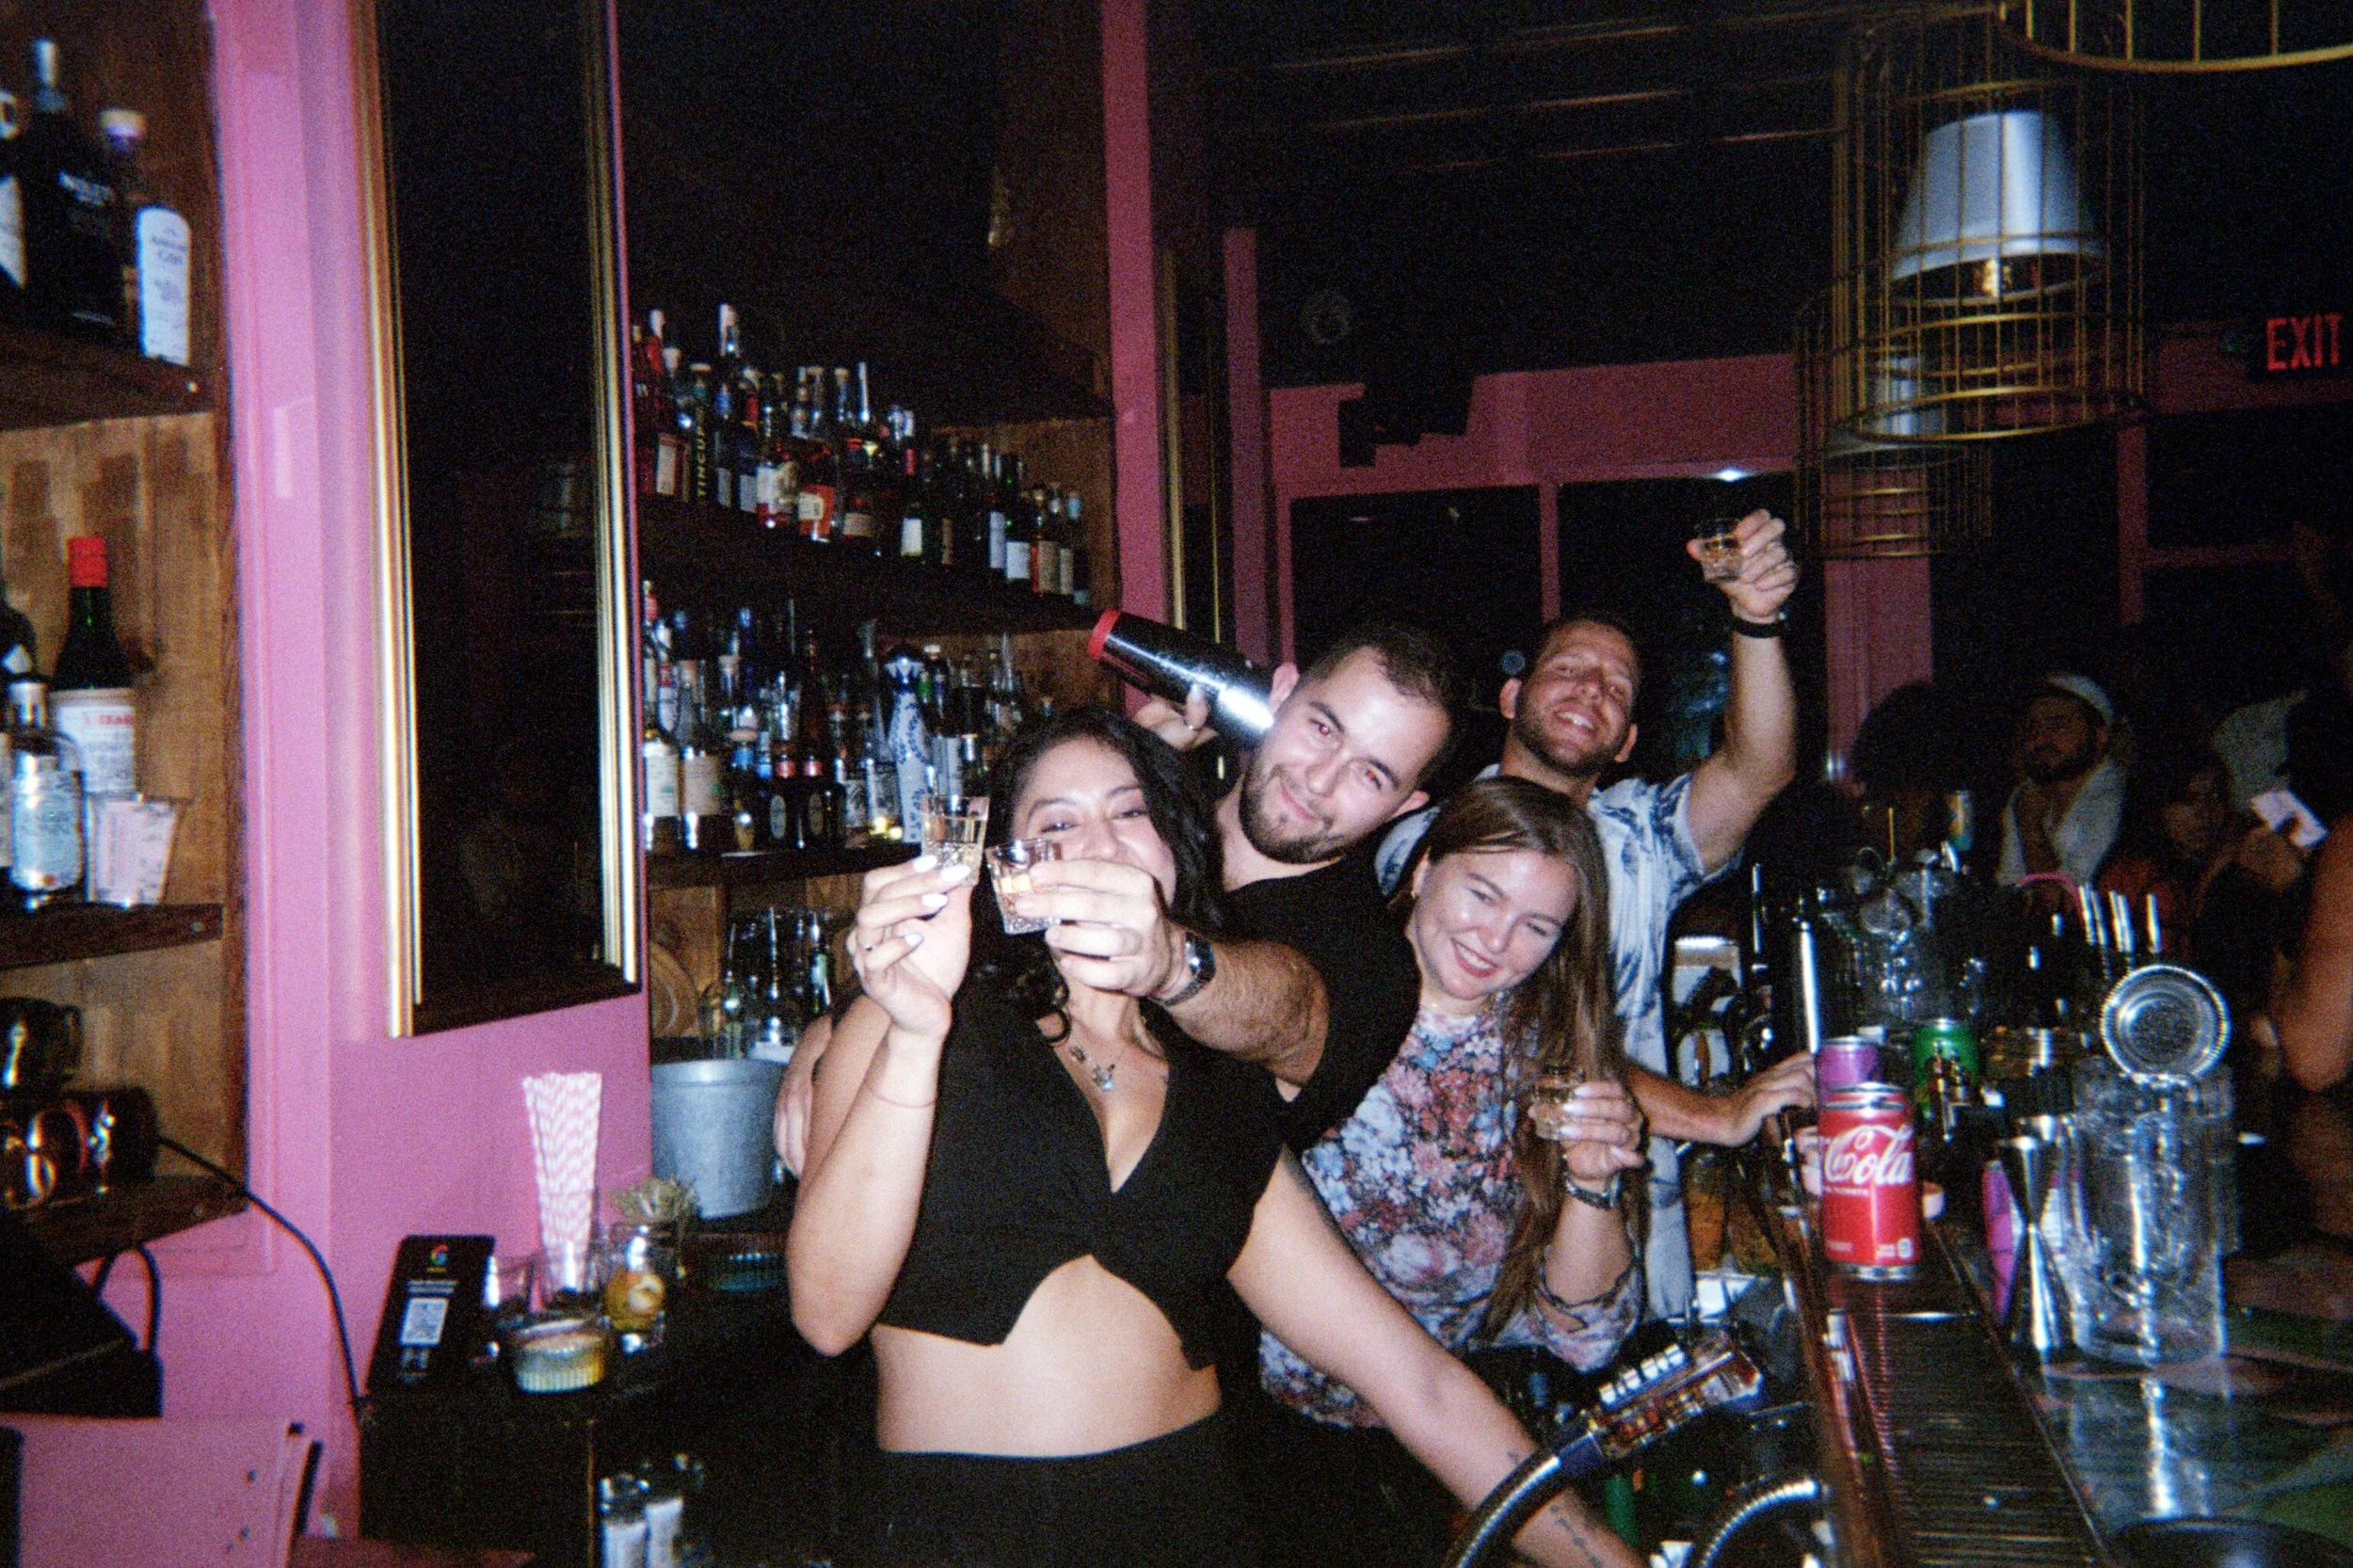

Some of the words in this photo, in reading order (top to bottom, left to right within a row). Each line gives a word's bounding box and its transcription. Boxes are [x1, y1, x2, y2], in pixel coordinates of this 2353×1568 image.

[2265, 312, 2343, 371] EXIT
[696, 425, 708, 498] TINCUP
[1824, 1124, 1913, 1185] Cola
